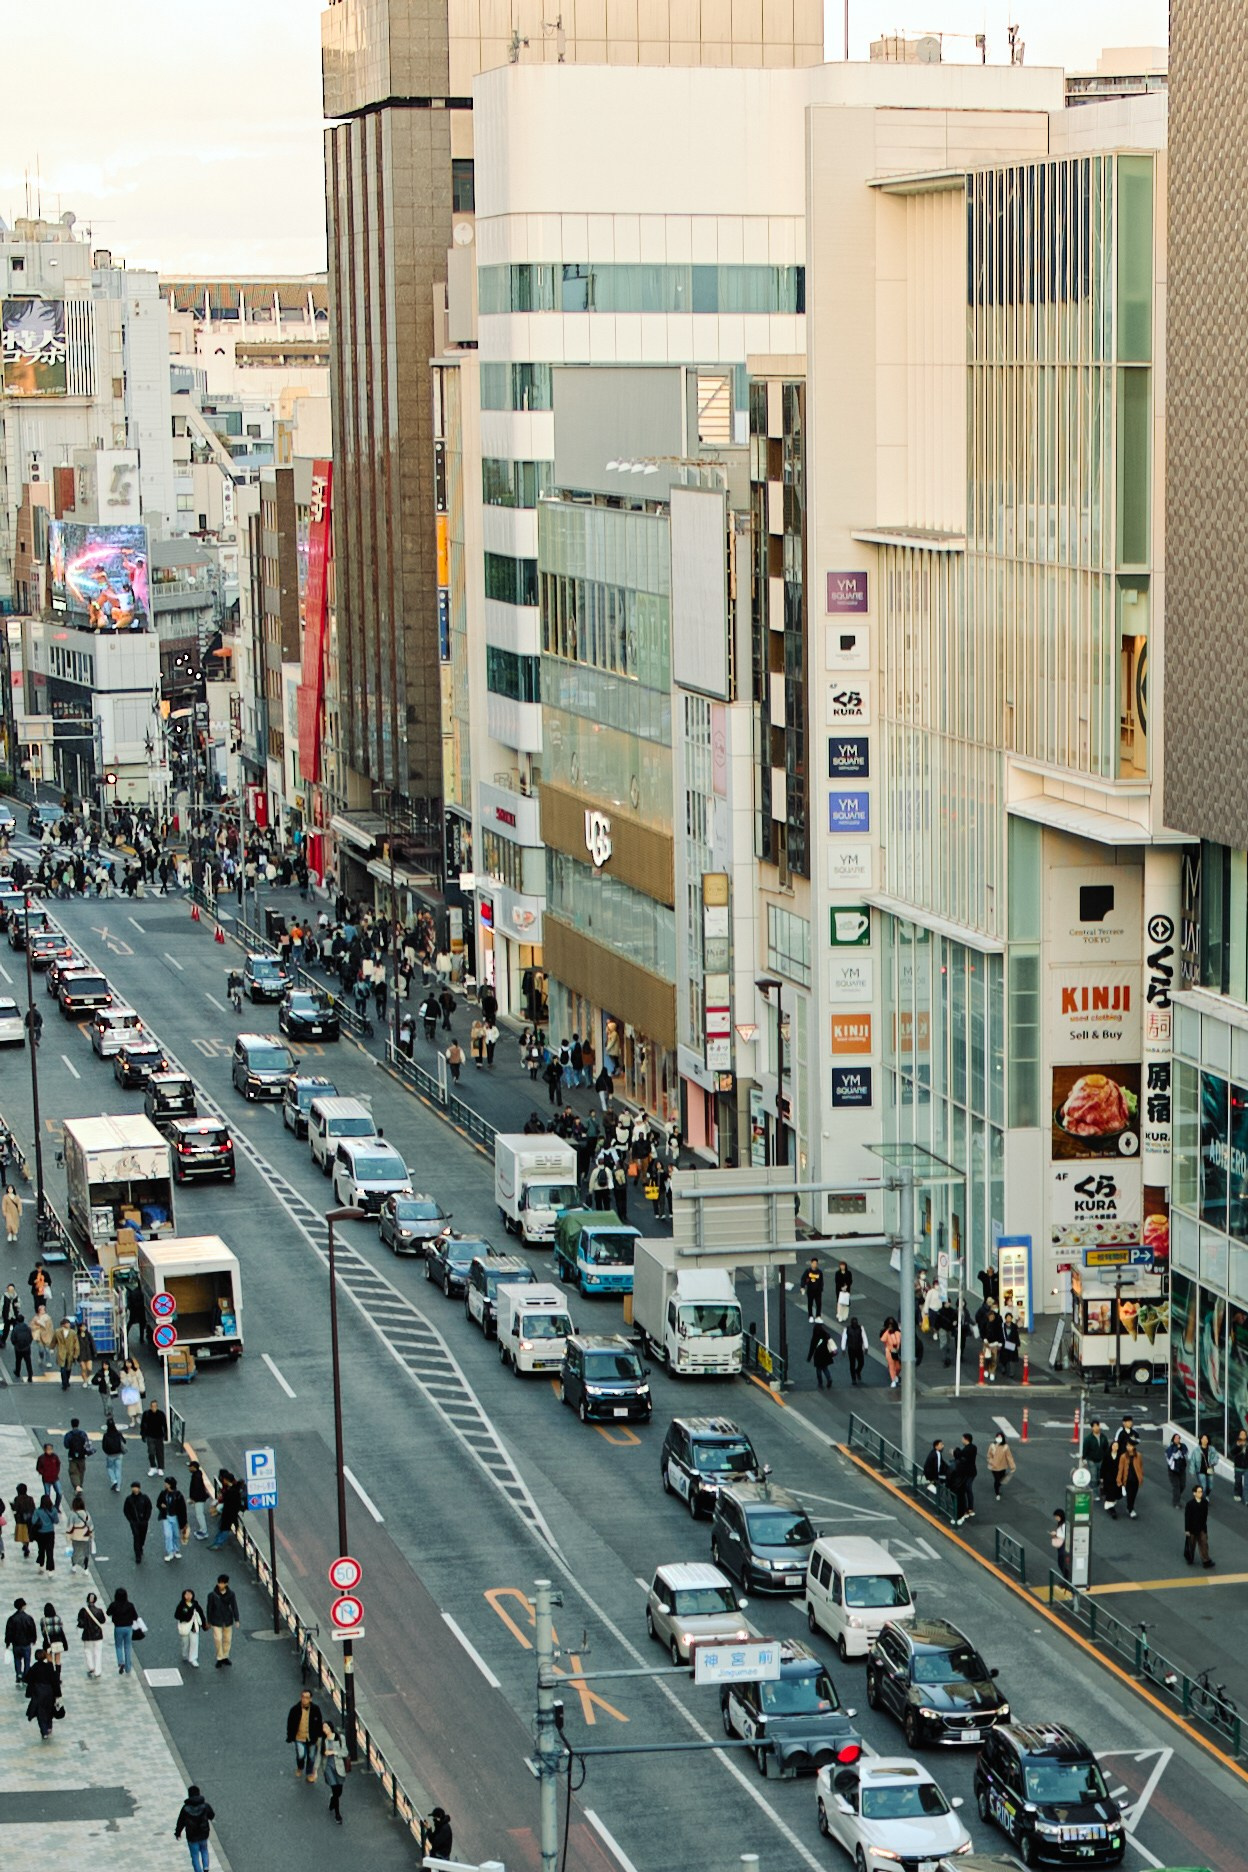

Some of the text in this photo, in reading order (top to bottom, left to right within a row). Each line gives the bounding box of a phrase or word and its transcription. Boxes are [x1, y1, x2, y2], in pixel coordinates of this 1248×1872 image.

[837, 579, 856, 591] YM
[832, 592, 863, 600] SQUARE
[833, 691, 862, 707] くら
[834, 708, 862, 716] KURA
[838, 744, 857, 757] YM
[839, 799, 858, 811] YM
[840, 854, 858, 865] YM
[1069, 928, 1124, 936] Central Terrace
[841, 968, 859, 978] YM
[1062, 985, 1130, 1015] KINJI
[834, 1025, 868, 1037] KINJI
[1070, 1030, 1122, 1041] Sell & Buy
[842, 1075, 860, 1086] YM
[1146, 1132, 1171, 1142] KUR
[1074, 1175, 1117, 1199] くら
[1074, 1200, 1117, 1211] KURA
[1131, 1249, 1140, 1263] P
[252, 1454, 268, 1476] P
[262, 1494, 275, 1507] IN
[336, 1566, 354, 1582] 50
[704, 1651, 773, 1668] 神宮前
